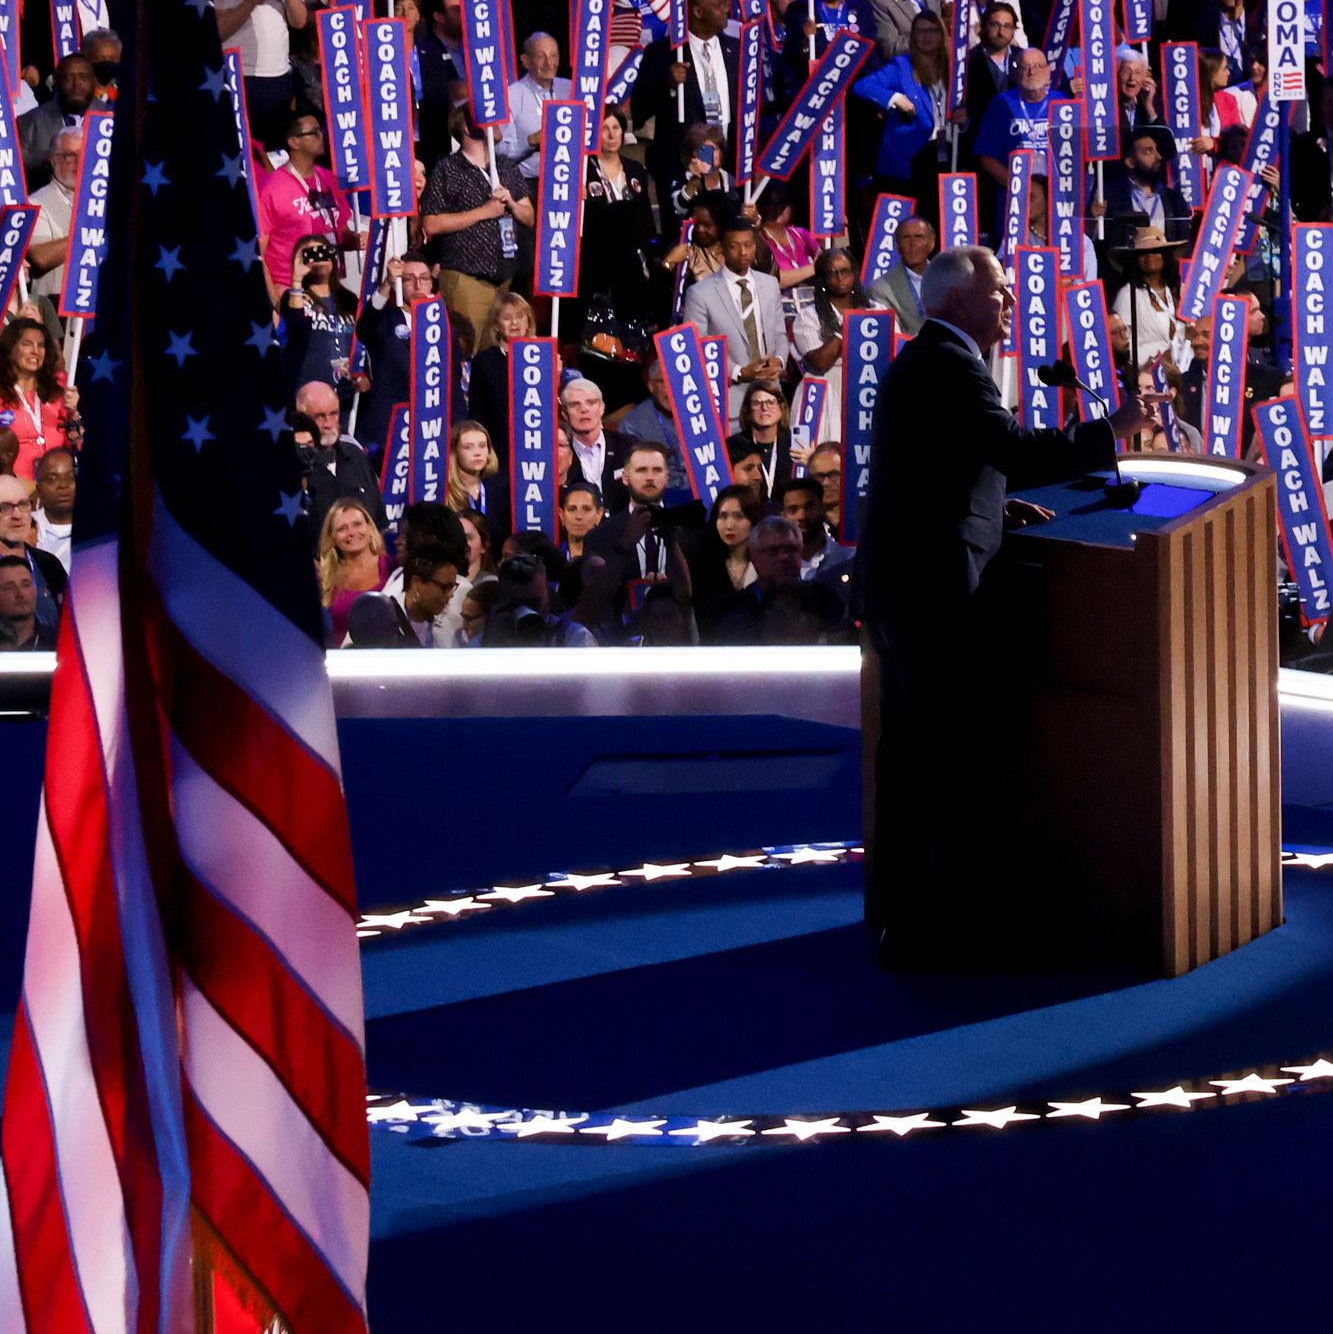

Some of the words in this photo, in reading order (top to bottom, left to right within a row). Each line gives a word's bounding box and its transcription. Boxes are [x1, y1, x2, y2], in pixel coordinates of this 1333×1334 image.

[475, 48, 496, 117] WALZ
[1092, 84, 1107, 152] WALZ
[1273, 73, 1281, 98] DNC
[1306, 230, 1323, 333] COACH
[424, 303, 441, 407] COACH
[1305, 346, 1327, 429] WALZ
[523, 344, 541, 449] COACH
[421, 420, 442, 501] WALZ
[522, 462, 545, 531] WAL
[1270, 405, 1308, 512] COACH
[1292, 523, 1330, 610] WALZ
